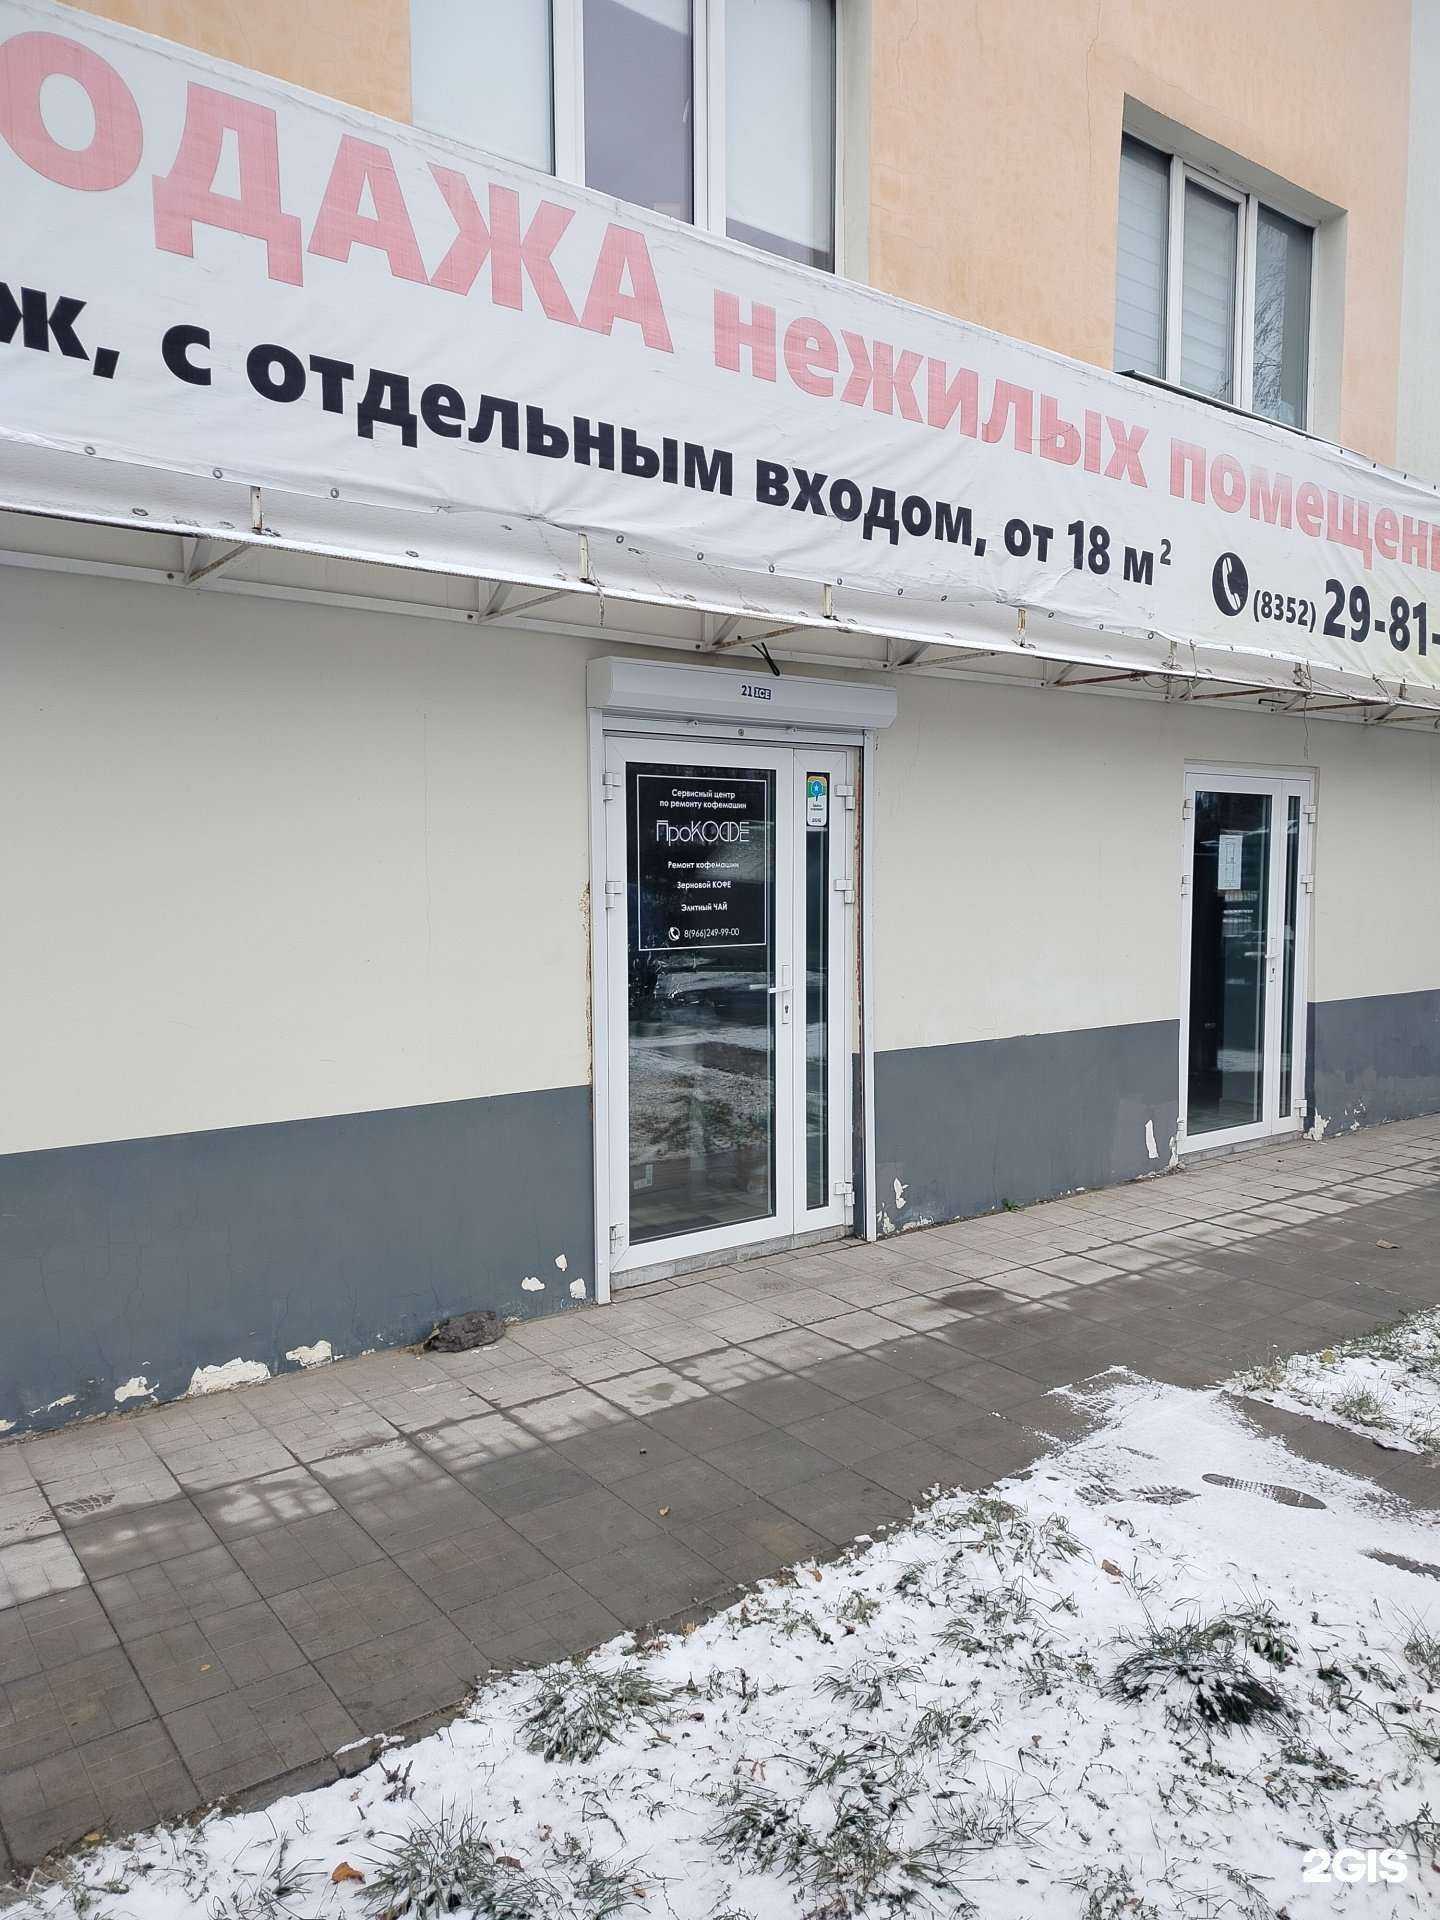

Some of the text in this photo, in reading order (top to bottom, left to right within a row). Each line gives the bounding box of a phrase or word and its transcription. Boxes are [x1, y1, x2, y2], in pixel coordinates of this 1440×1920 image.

[714, 288, 1149, 488] нежилых
[162, 324, 211, 386] с
[246, 343, 733, 496] отдельным
[756, 459, 987, 557] входом,
[1004, 518, 1054, 562] от
[1067, 520, 1111, 575] 18
[1253, 589, 1317, 634] (8352)
[671, 788, 736, 799] Сервисный центр
[670, 801, 702, 809] ремонту
[703, 801, 747, 810] кофемашин
[656, 819, 750, 847] ПроКОФЕ
[667, 861, 740, 870] Ремонт кофемашин
[677, 880, 732, 891] Зерновой КОФЕ
[681, 901, 728, 912] Элитный ЧАЙ
[683, 927, 740, 939] 8(966)249-99-00
